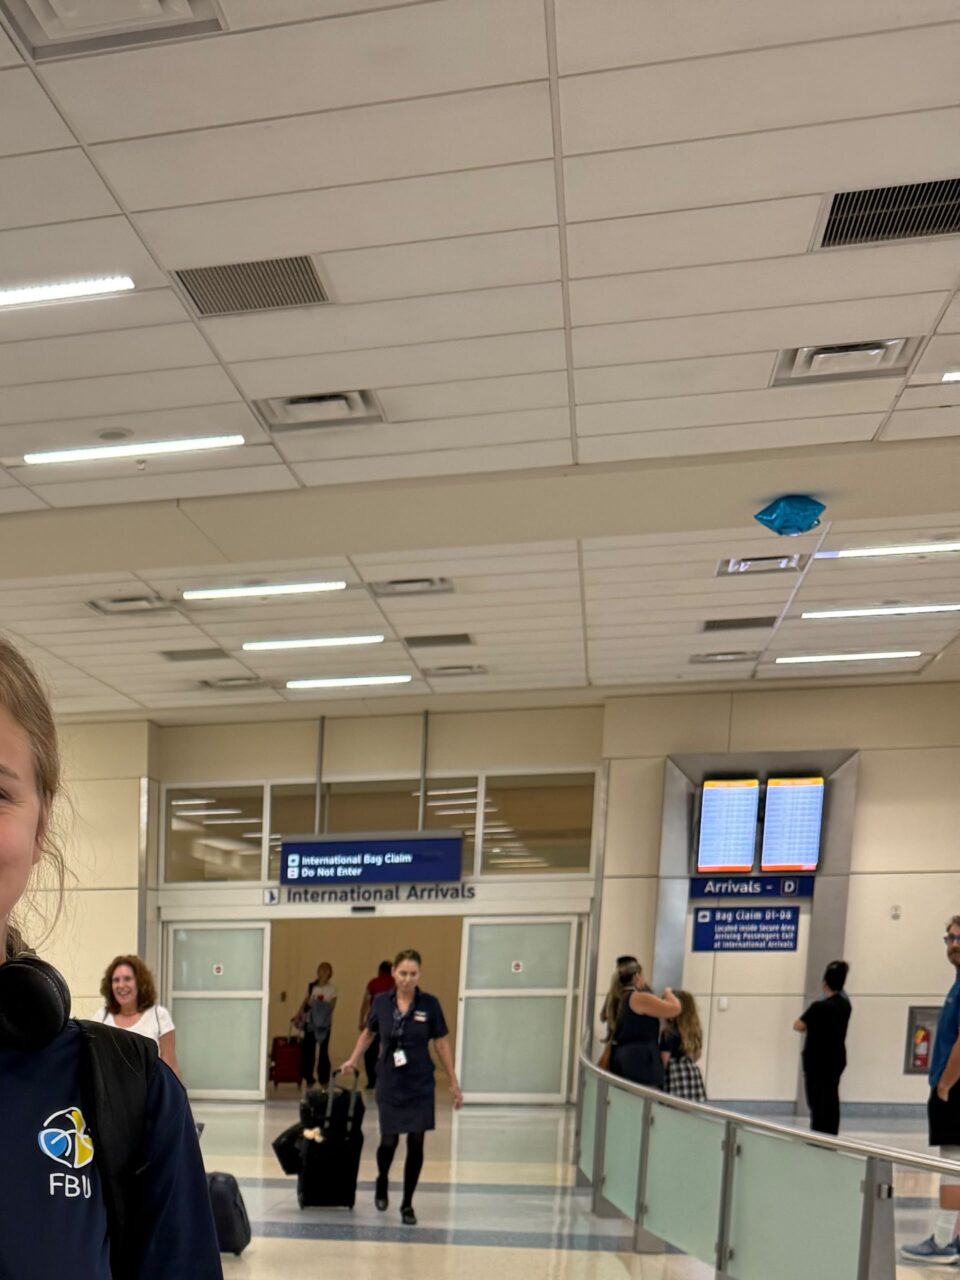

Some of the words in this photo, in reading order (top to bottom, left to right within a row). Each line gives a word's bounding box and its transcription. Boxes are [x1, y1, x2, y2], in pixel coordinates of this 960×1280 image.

[302, 853, 362, 865] International
[364, 853, 383, 866] Bag
[385, 852, 413, 864] Claim
[301, 867, 315, 877] Do
[317, 866, 335, 877] Not
[337, 866, 363, 877] Enter
[287, 884, 399, 902] International
[407, 884, 475, 900] Arrivals
[704, 880, 761, 893] Arrivals
[784, 881, 795, 893] D
[715, 910, 732, 922] Bag
[735, 909, 762, 920] Claim
[768, 941, 794, 949] Arrivals
[50, 1172, 92, 1199] FBU
